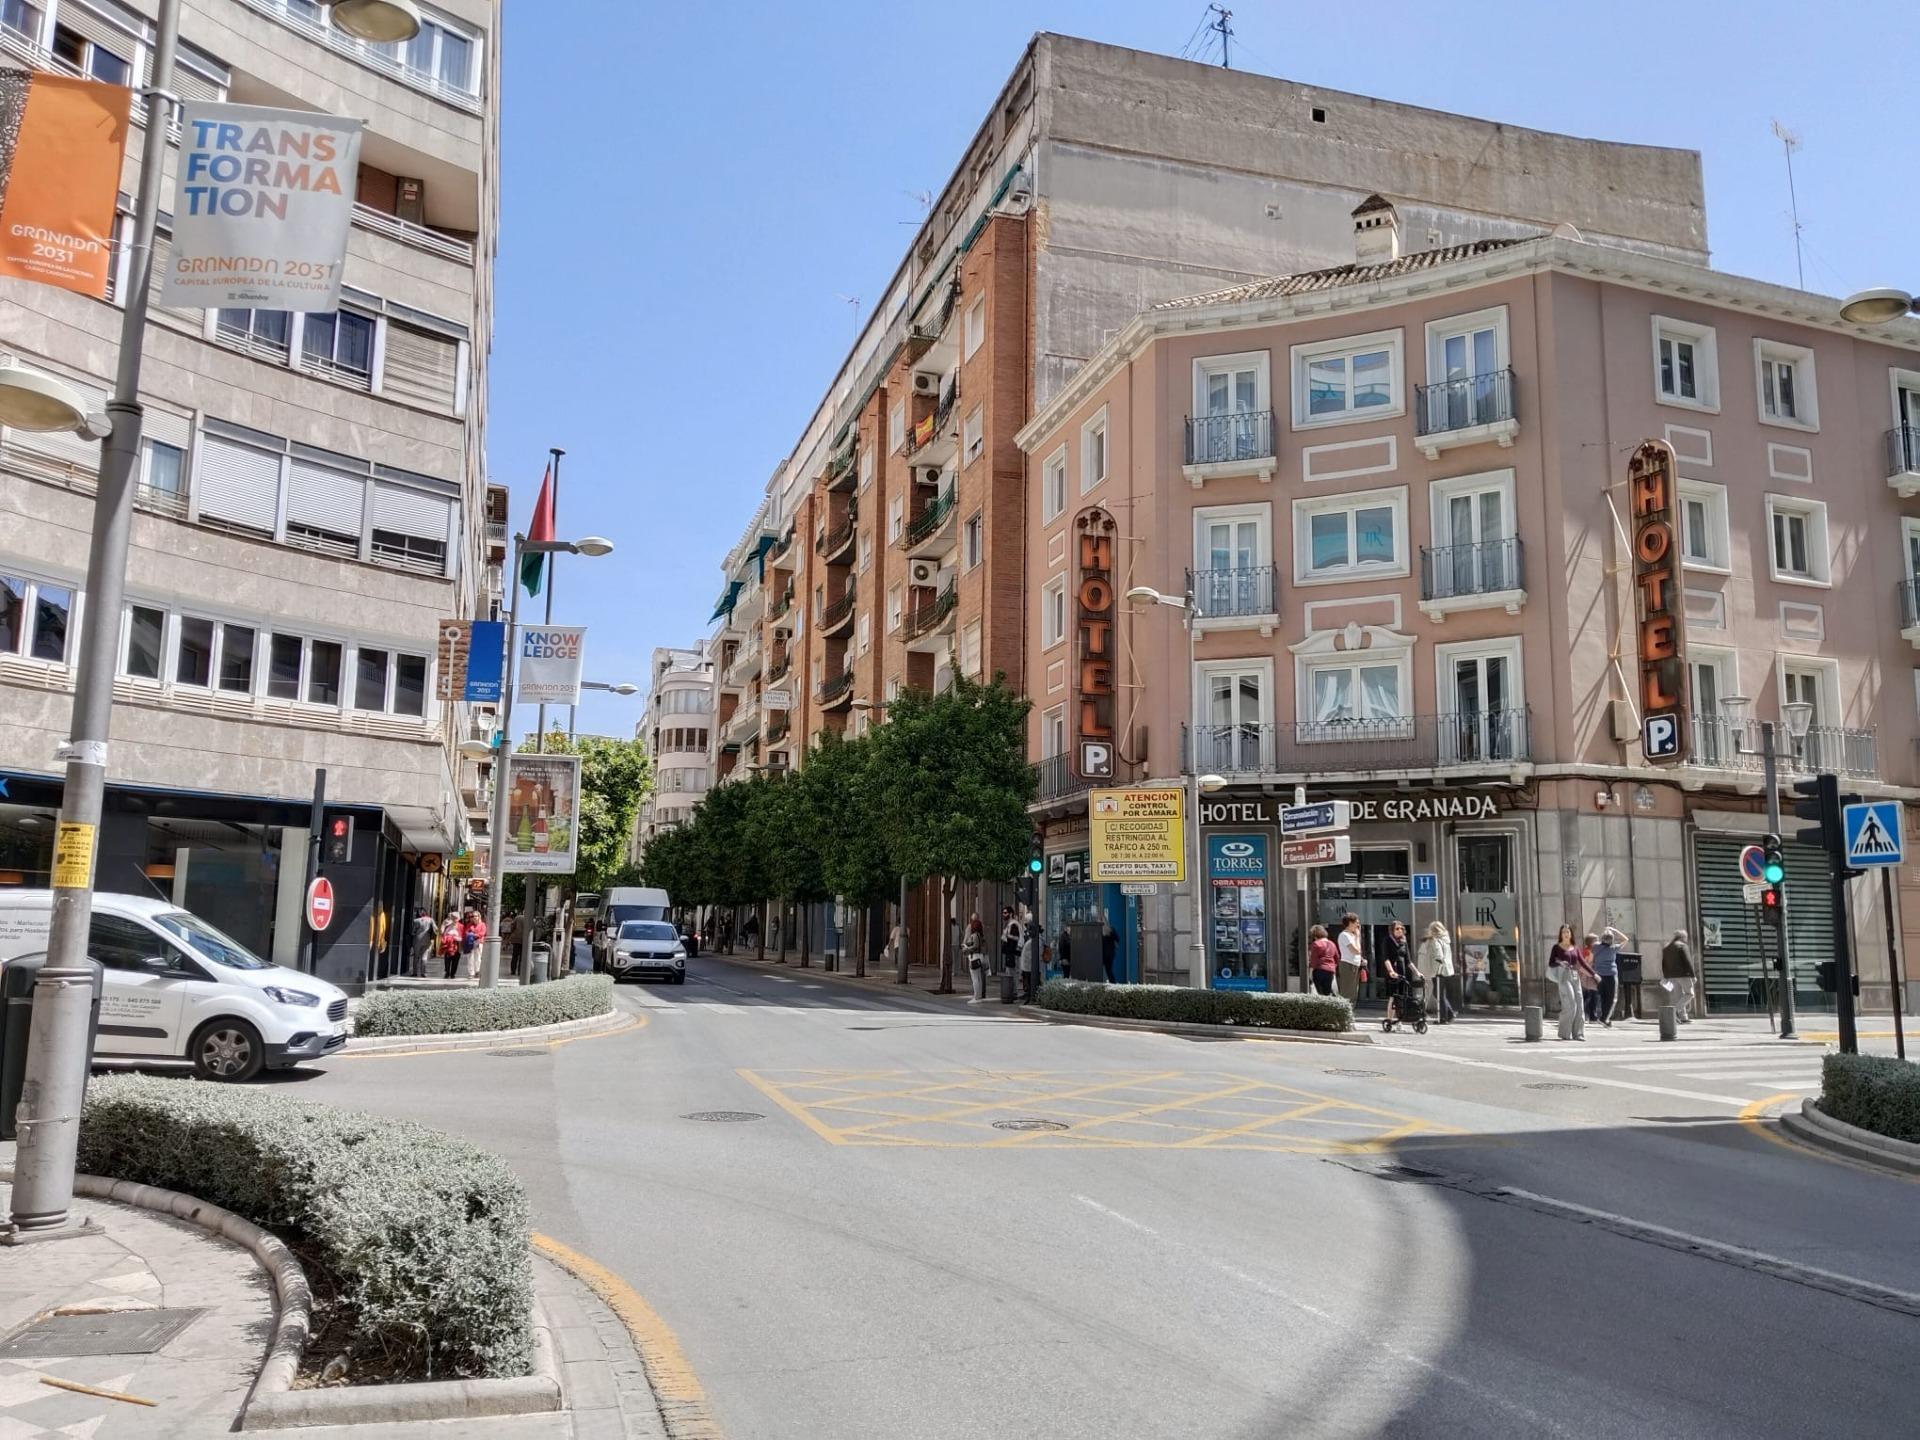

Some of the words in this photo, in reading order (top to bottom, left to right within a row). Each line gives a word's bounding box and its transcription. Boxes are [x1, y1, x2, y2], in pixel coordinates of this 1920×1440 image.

[191, 120, 336, 162] TRANS
[186, 154, 342, 195] FORMA
[184, 186, 288, 221] TION
[11, 225, 99, 254] GRANADA
[32, 243, 73, 263] 2031
[177, 257, 279, 274] GRANADA
[284, 260, 334, 280] 2031
[174, 278, 210, 286] CAPITAL
[213, 277, 255, 286] EUROPEA
[258, 278, 270, 287] DE
[272, 279, 284, 288] LA
[287, 280, 330, 291] CULTURA
[1633, 470, 1677, 710] HOTEL
[525, 631, 580, 646] KNOW
[1079, 534, 1113, 737] HOTEL
[523, 645, 577, 660] LEDGE
[1650, 720, 1672, 753] P
[1086, 745, 1108, 774] P
[1124, 793, 1177, 802] ATENCIÓN
[1142, 809, 1178, 817] CÁMARA
[1200, 803, 1270, 825] HOTEL
[1350, 801, 1378, 821] DE
[1384, 796, 1497, 822] GRANADA
[1119, 823, 1164, 831] RECOGIDAS
[1104, 843, 1138, 851] TRÁFICO
[1139, 843, 1146, 851] A
[1147, 843, 1160, 851] 250
[1213, 857, 1263, 869] TORRES
[1419, 876, 1430, 890] H
